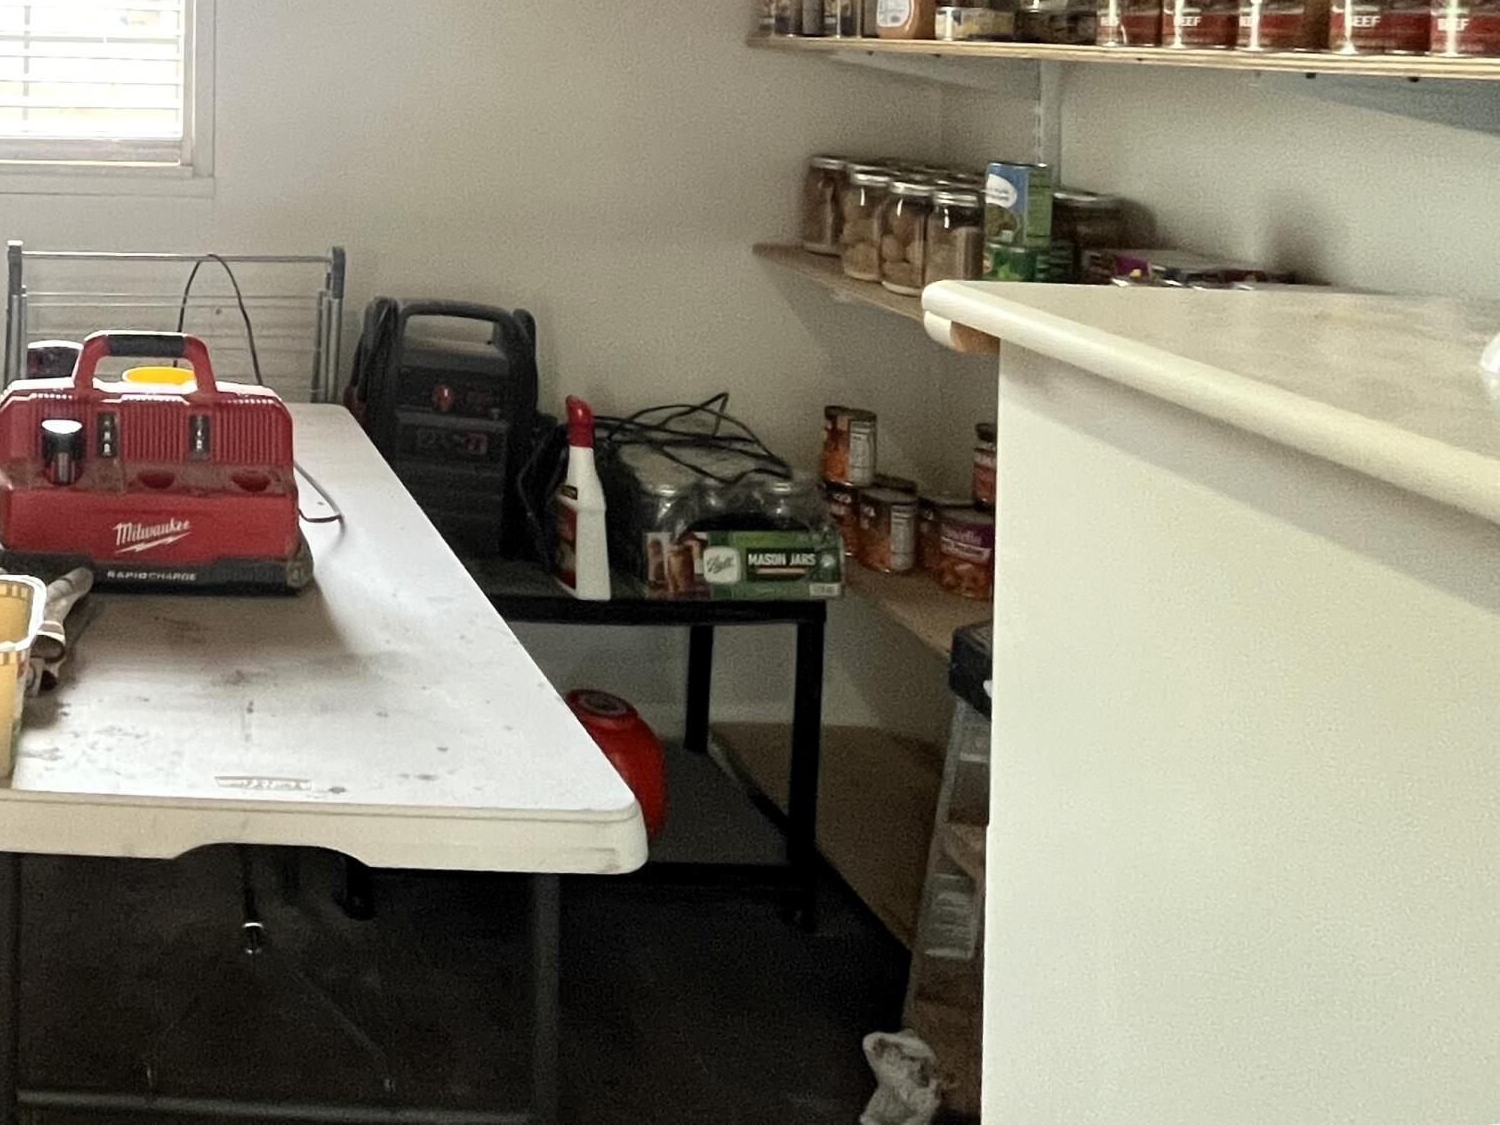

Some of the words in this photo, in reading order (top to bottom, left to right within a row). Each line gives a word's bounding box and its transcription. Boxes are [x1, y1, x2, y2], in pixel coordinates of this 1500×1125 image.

[110, 517, 193, 546] Milwaukee
[748, 552, 787, 567] MASON
[789, 552, 816, 567] JARS
